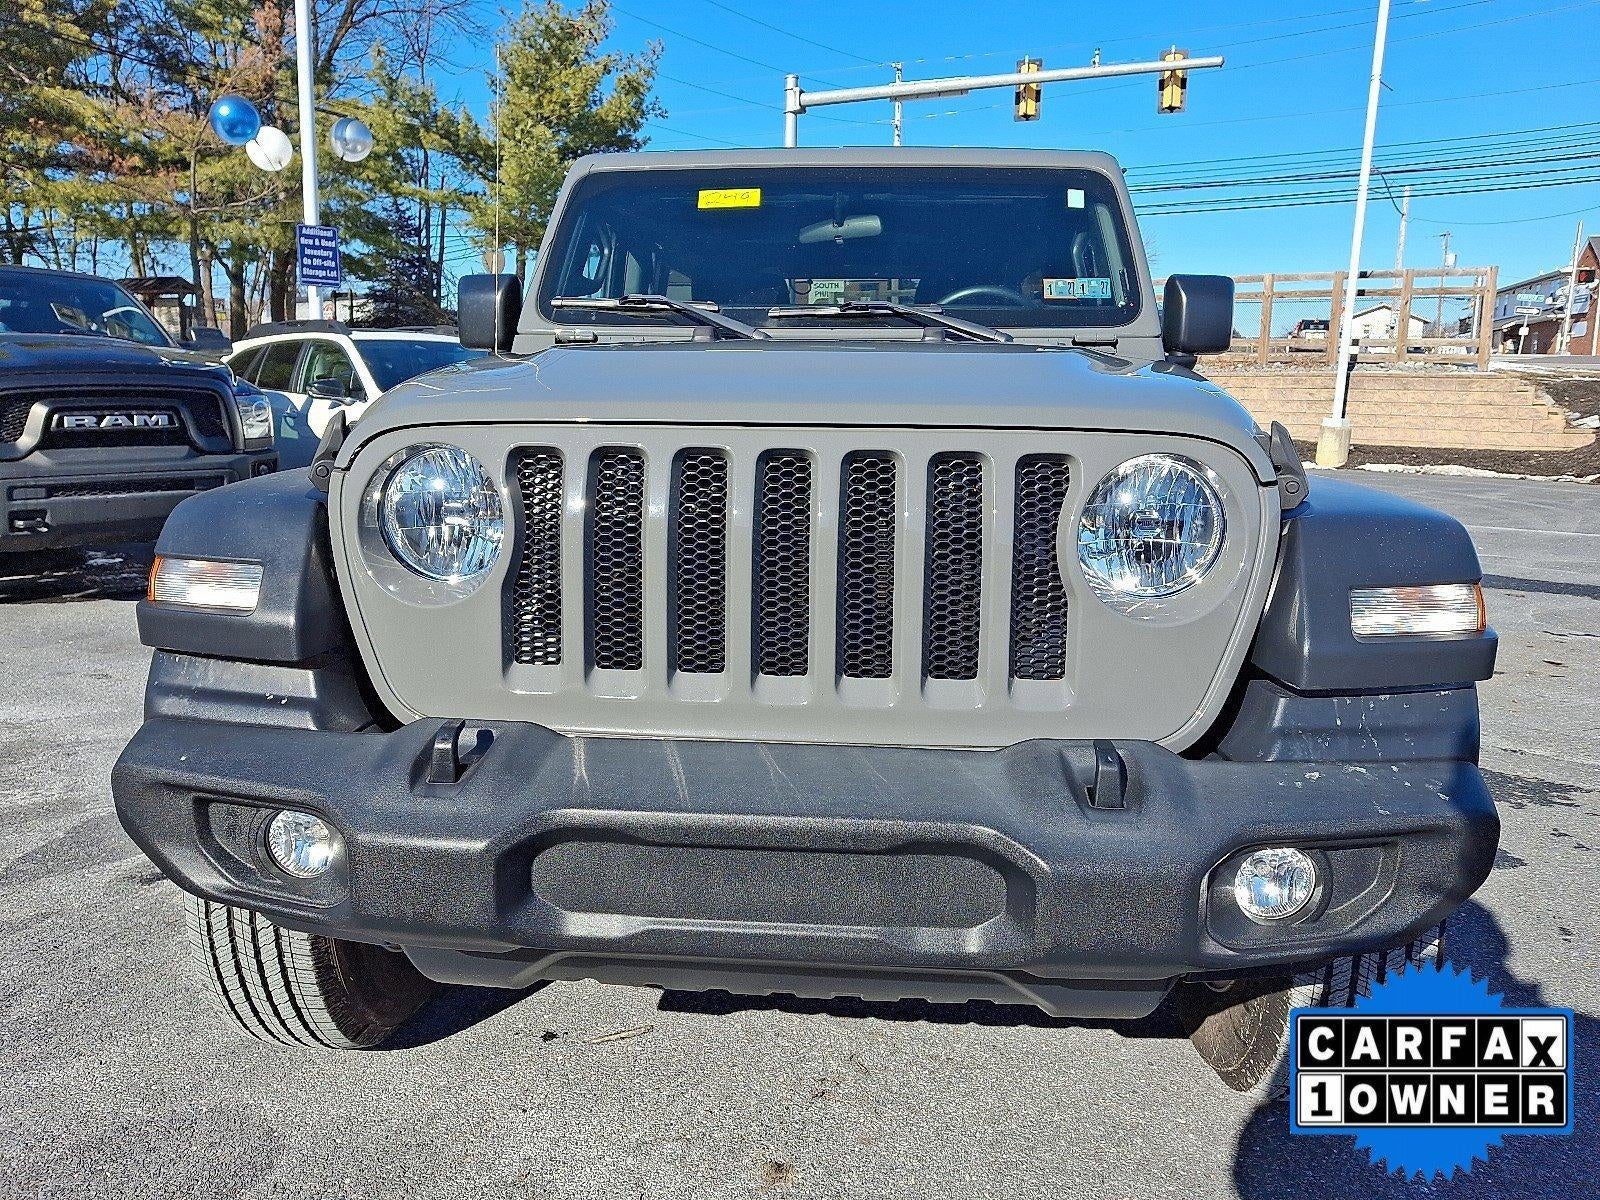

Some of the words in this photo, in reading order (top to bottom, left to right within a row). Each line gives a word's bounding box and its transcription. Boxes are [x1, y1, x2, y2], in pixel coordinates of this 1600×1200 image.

[302, 227, 333, 237] Additional
[300, 237, 313, 245] New
[315, 238, 320, 246] &
[321, 239, 336, 247] Used
[304, 247, 333, 258] Inventory
[303, 257, 311, 265] On
[313, 258, 336, 267] Off-site
[303, 267, 326, 277] Storage
[327, 269, 337, 277] Lot
[813, 282, 840, 290] SOUTH
[64, 414, 169, 428] RAM
